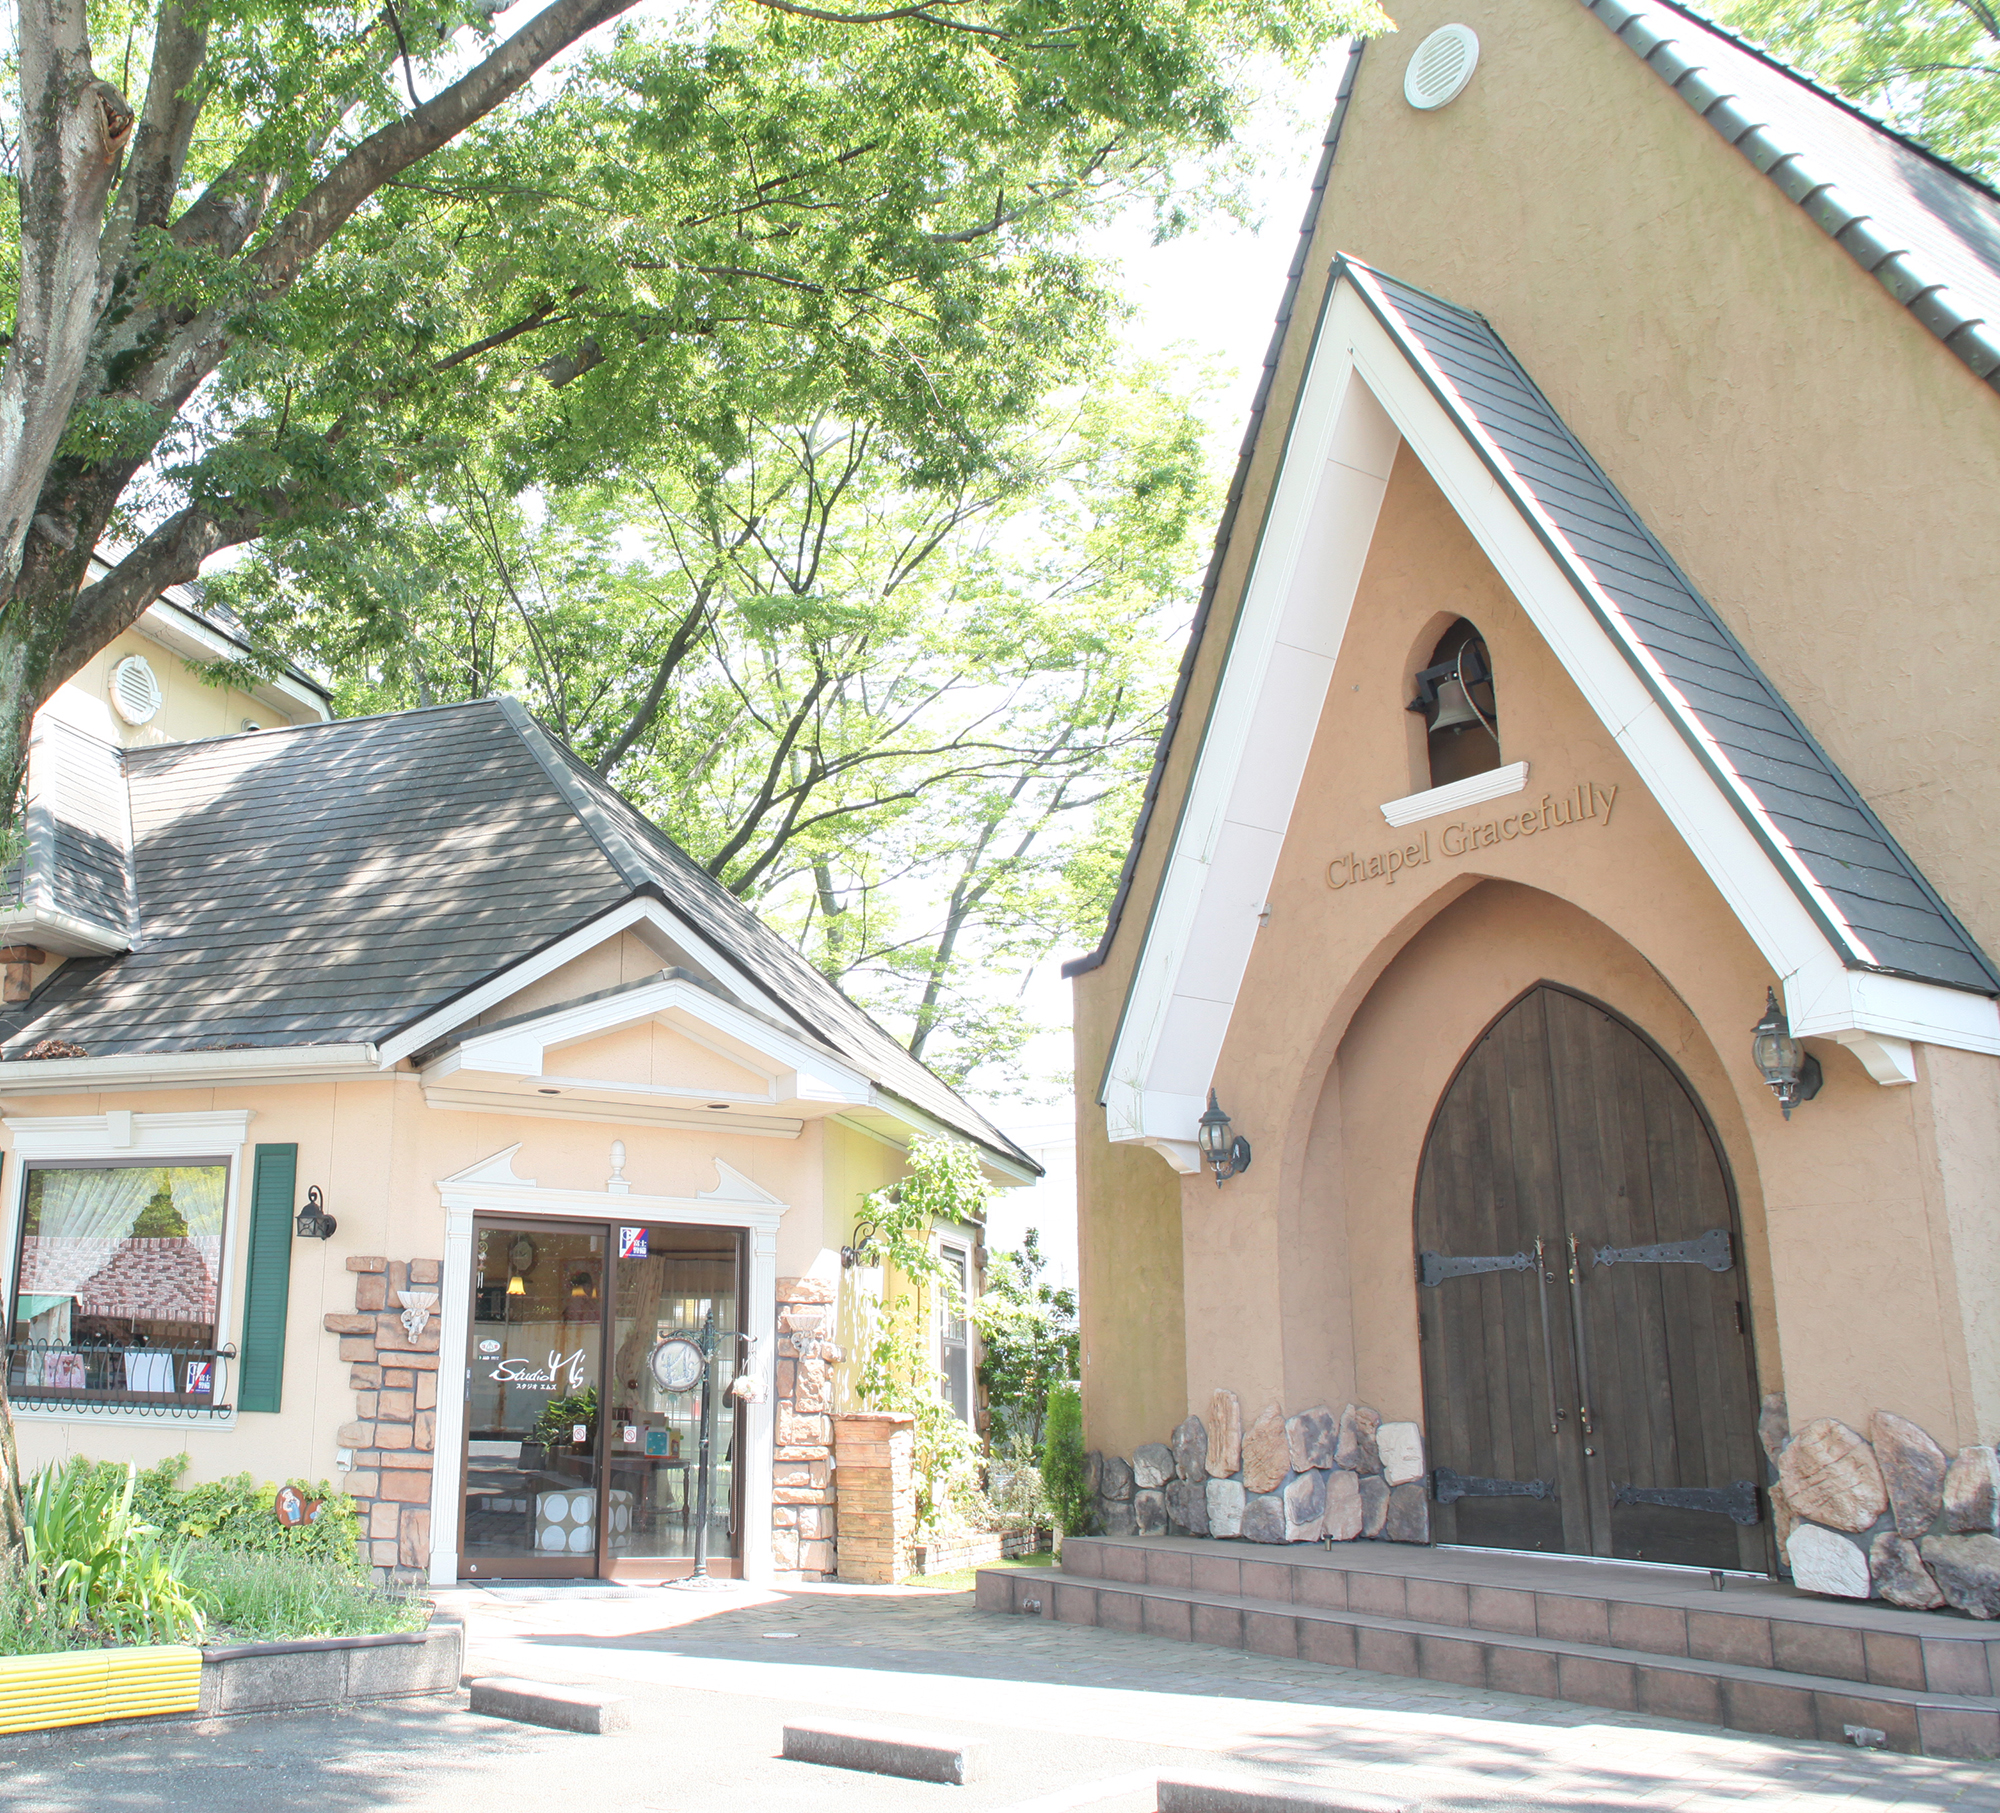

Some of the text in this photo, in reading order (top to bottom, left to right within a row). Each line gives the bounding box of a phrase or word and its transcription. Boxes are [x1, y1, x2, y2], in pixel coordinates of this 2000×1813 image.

[1325, 782, 1618, 889] Chapel Gracefully
[489, 1358, 549, 1381] Studio
